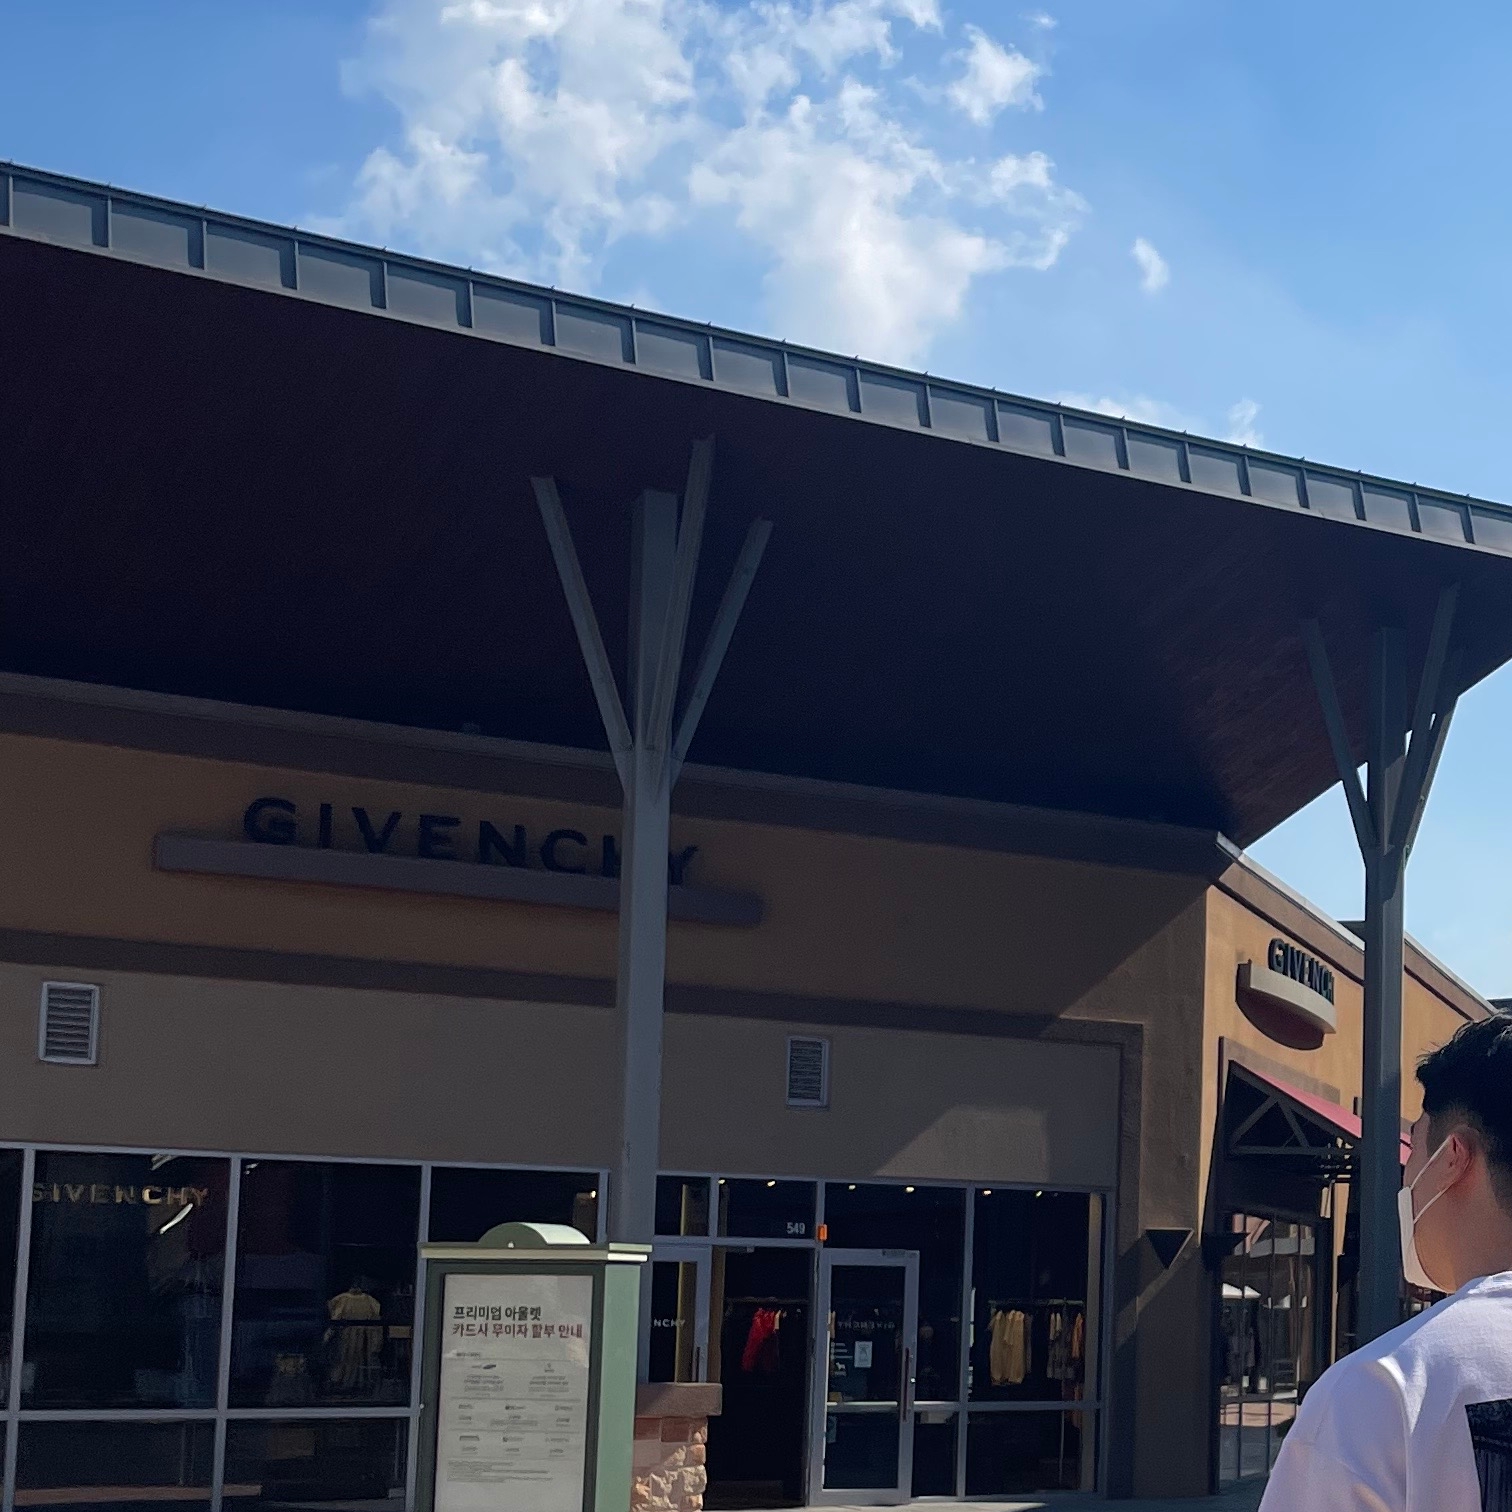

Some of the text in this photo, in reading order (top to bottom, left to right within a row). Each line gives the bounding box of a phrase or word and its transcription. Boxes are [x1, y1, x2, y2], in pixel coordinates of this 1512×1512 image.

[786, 1222, 806, 1235] 549
[452, 1323, 583, 1339] 카드사 무이자 할부 안내
